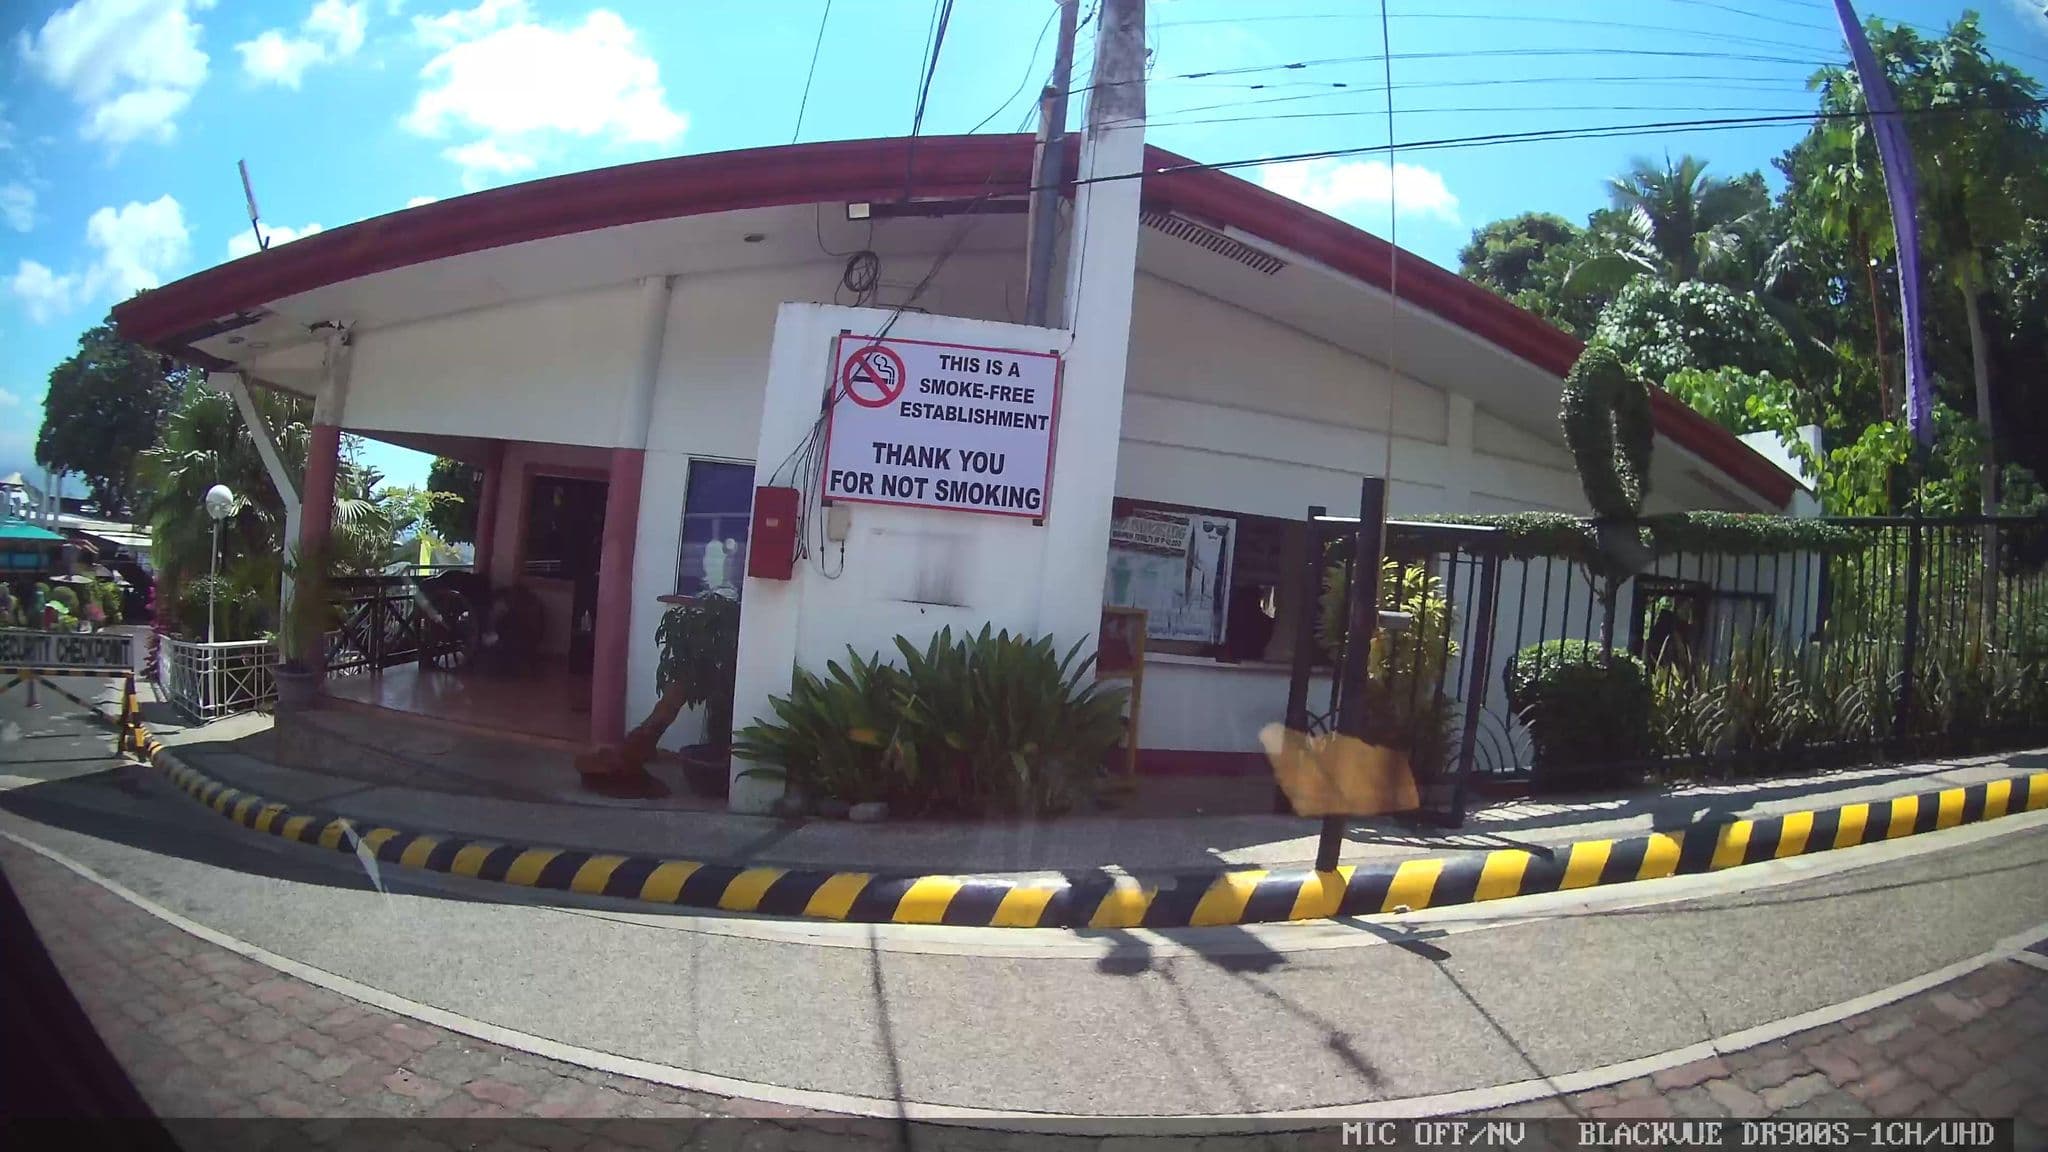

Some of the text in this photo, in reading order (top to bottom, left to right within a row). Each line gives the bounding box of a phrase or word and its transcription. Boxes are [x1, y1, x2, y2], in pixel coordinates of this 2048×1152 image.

[939, 354, 1020, 377] THIS IS A
[919, 378, 1035, 403] SMOKE-FREE
[900, 402, 1049, 430] ESTABLISHMENT
[872, 442, 1005, 475] THANK YOU
[830, 470, 1041, 509] FOR NOT SMOKING
[57, 637, 130, 665] CHECKPOINT
